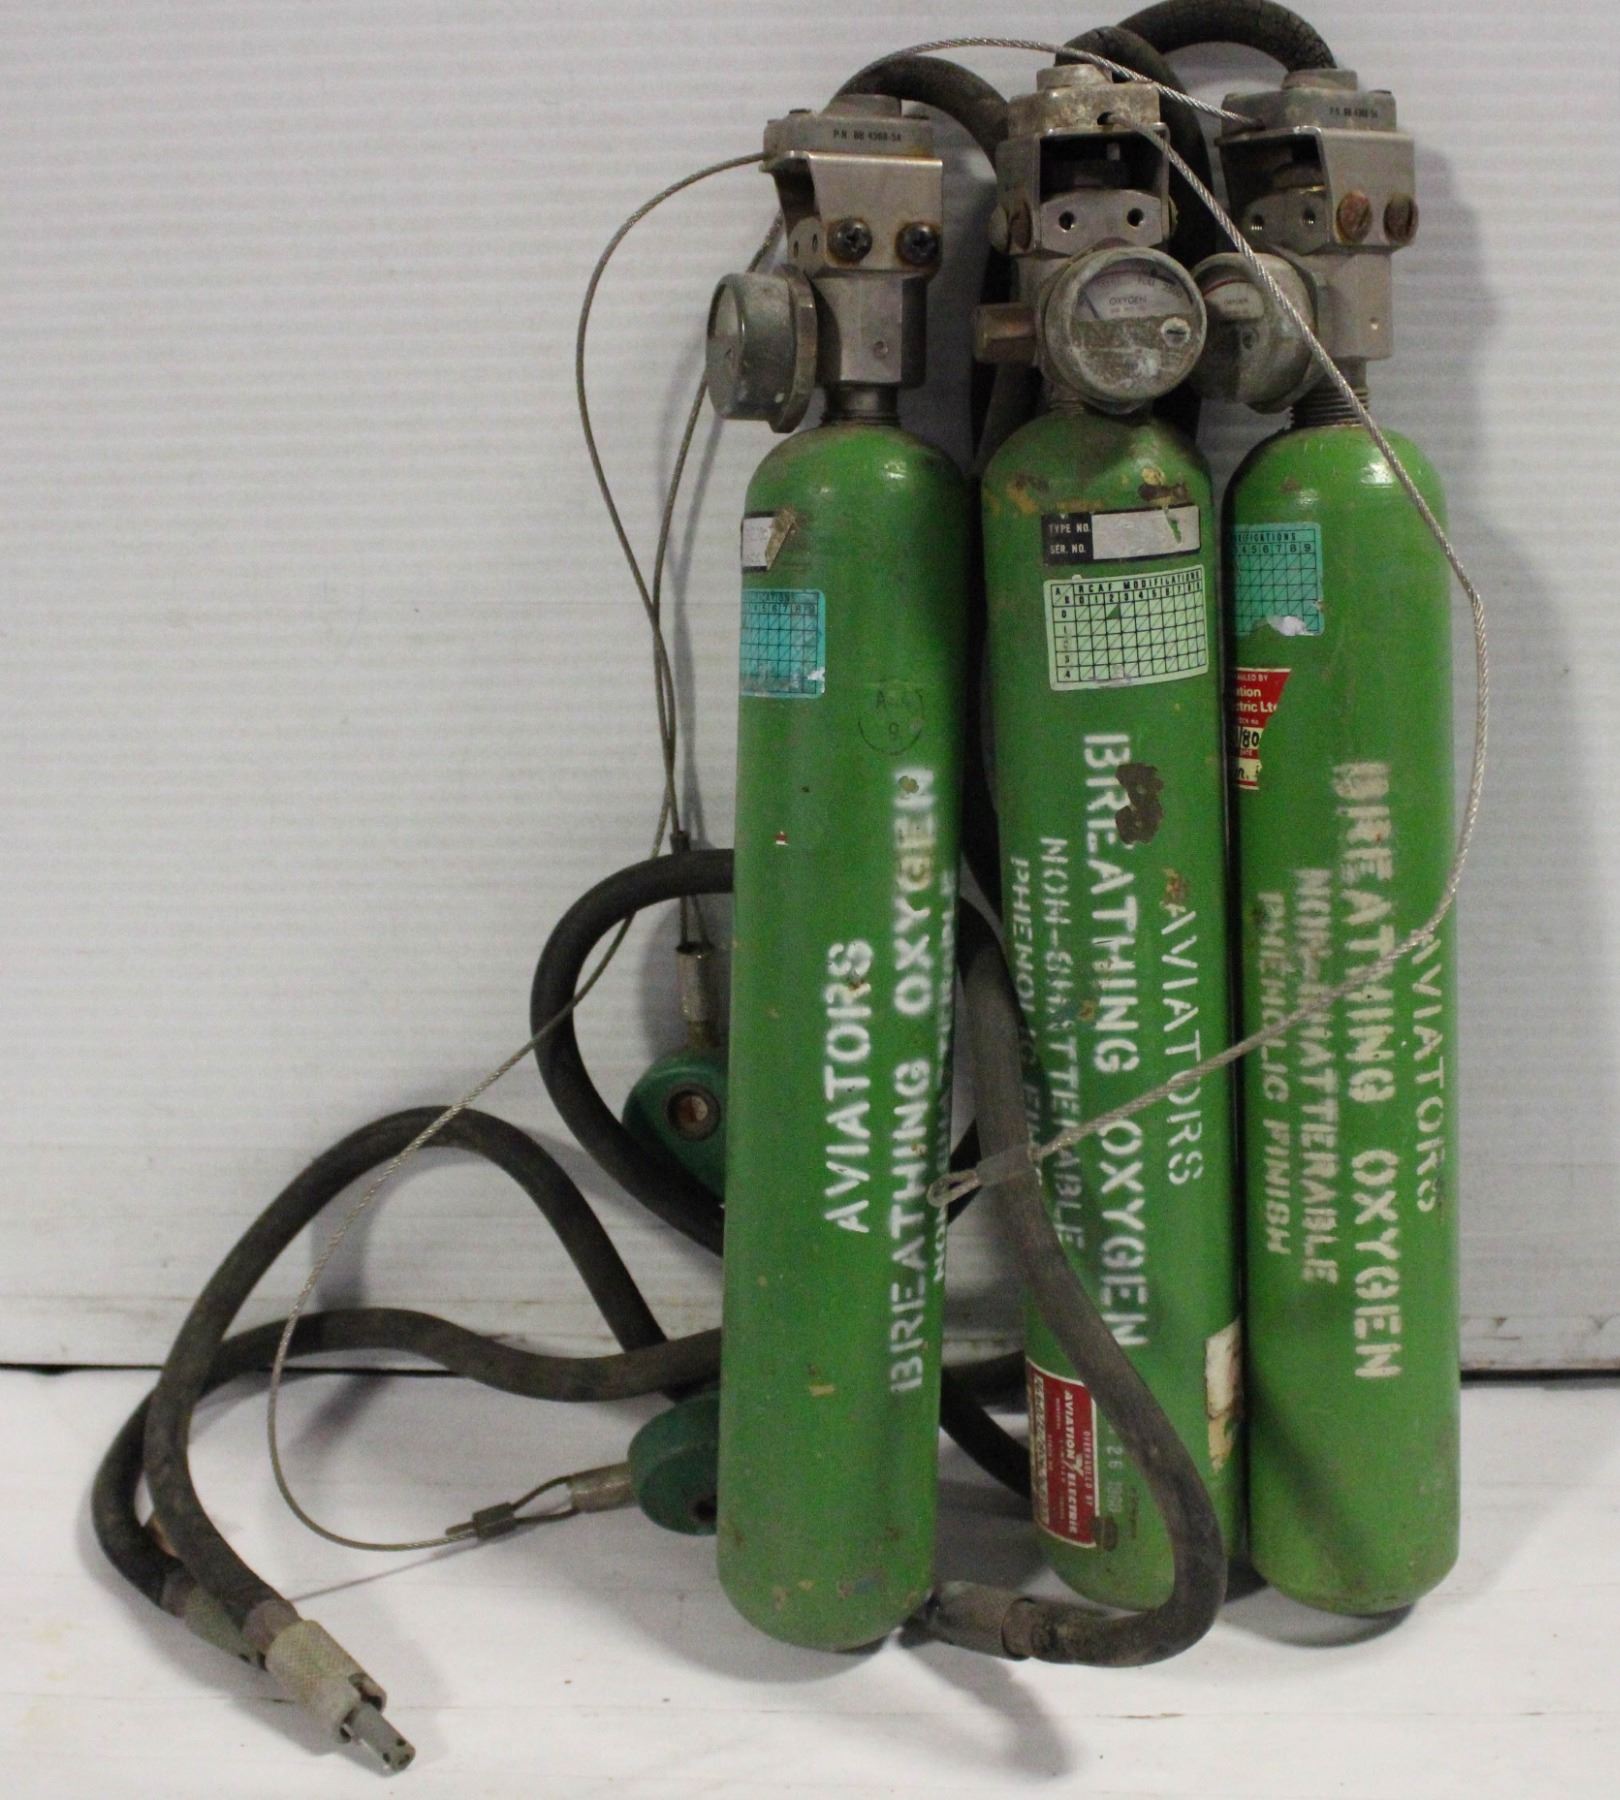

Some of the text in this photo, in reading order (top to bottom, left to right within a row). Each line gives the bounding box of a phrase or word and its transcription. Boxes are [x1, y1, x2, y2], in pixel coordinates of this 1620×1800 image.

[1048, 523, 1072, 534] TYPE
[1237, 700, 1258, 712] tric
[824, 938, 874, 1234] AVIATORS
[890, 766, 938, 1394] BREATHING OXYGEN
[1083, 733, 1149, 1346] BREATHING OXYGEN
[1160, 902, 1205, 1186] AVIATORS
[1332, 761, 1402, 1379] BREATHING OXYGEN
[1064, 1390, 1079, 1534] AVIATION ELECTRIC
